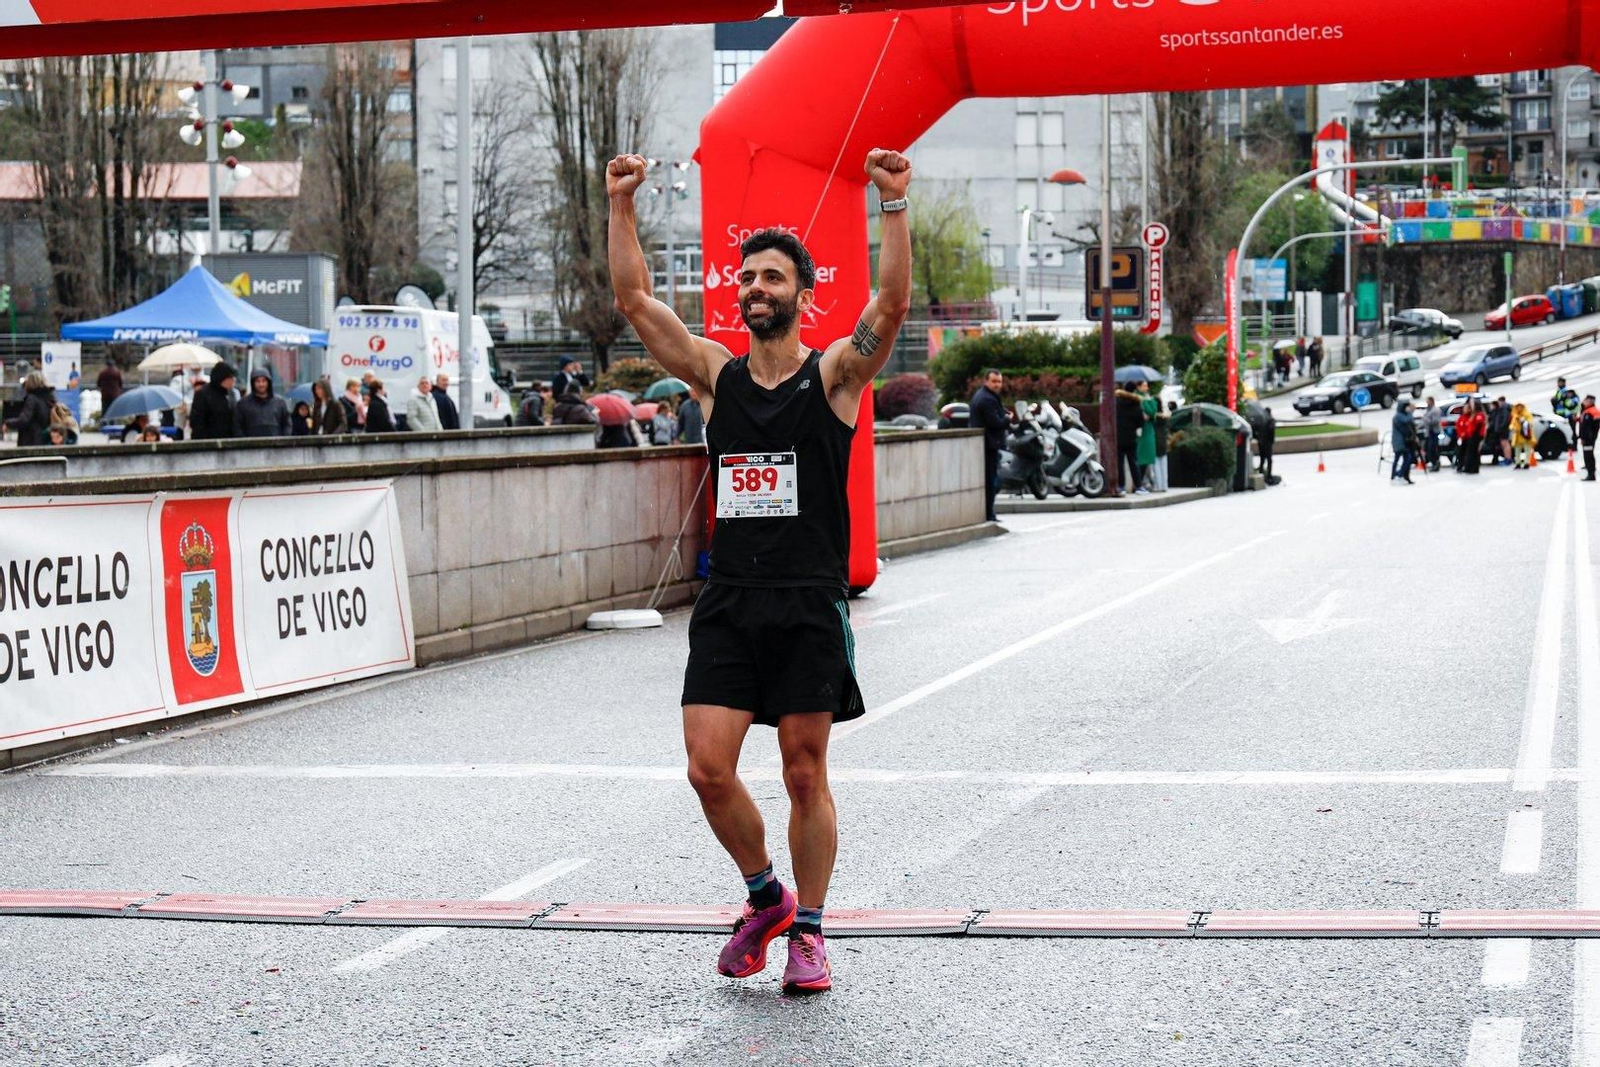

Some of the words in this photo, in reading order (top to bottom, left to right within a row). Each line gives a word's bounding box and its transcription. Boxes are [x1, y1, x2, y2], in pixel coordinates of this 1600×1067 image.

[1160, 23, 1343, 51] sportssantander.es
[727, 223, 799, 249] Sps
[1148, 227, 1163, 244] P
[252, 279, 303, 294] McFIT
[1150, 250, 1161, 320] PARKING
[339, 316, 360, 327] 902
[365, 316, 380, 328] 55
[384, 317, 399, 328] 78
[403, 317, 418, 328] 98
[341, 354, 413, 370] OneFurgO
[732, 467, 778, 492] 589
[260, 530, 374, 582] CONCELLO
[277, 595, 307, 640] DE
[312, 587, 367, 633] VIGO
[0, 629, 35, 684] DE
[41, 620, 115, 676] VIGO
